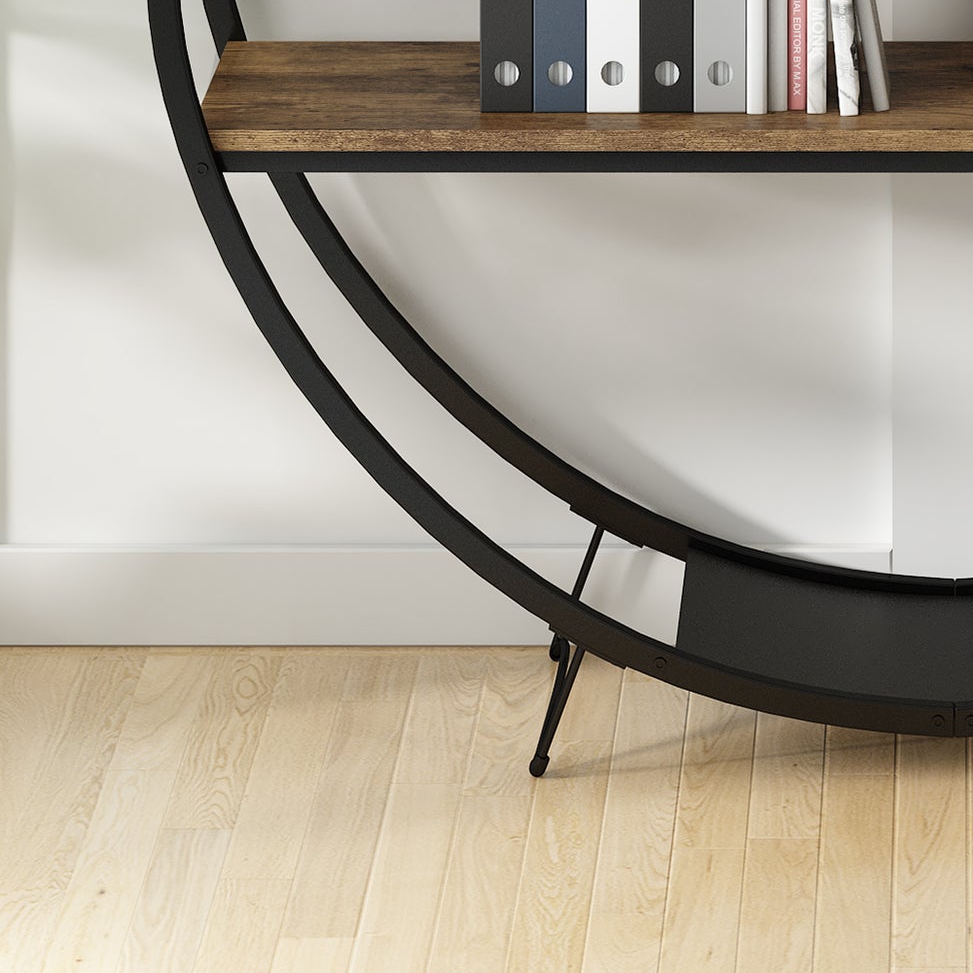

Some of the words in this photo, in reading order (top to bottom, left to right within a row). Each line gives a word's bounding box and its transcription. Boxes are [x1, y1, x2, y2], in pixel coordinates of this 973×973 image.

[792, 17, 801, 54] EDITOR
[811, 7, 825, 59] MONK
[792, 56, 801, 69] BY
